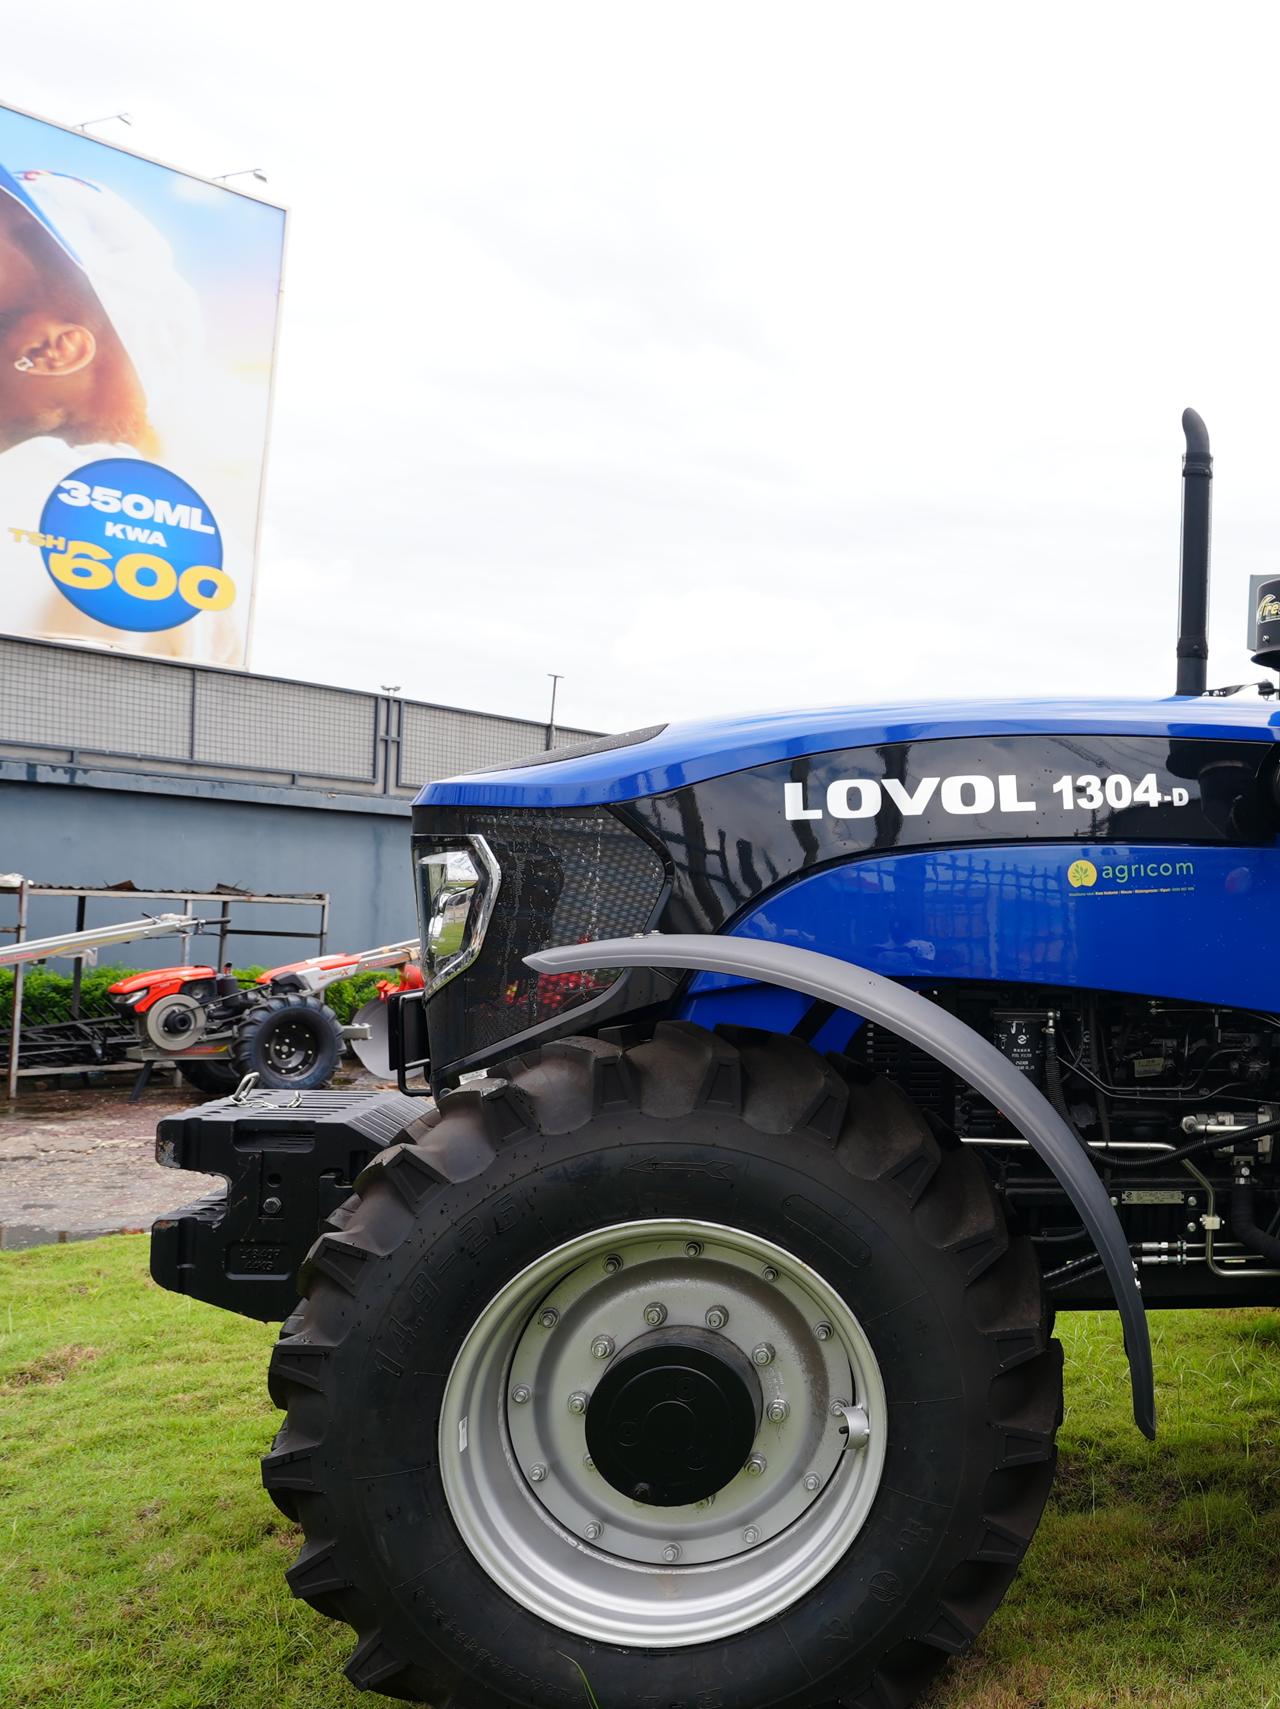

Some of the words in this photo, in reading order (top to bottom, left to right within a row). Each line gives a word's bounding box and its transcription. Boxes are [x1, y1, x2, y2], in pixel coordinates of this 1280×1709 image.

[57, 480, 215, 535] 350ML
[8, 527, 68, 550] TSH
[104, 521, 167, 547] KWA
[49, 540, 237, 611] 600
[784, 774, 1037, 821] LOVOL
[1053, 773, 1189, 810] 1304-D
[1102, 862, 1194, 883] agricom
